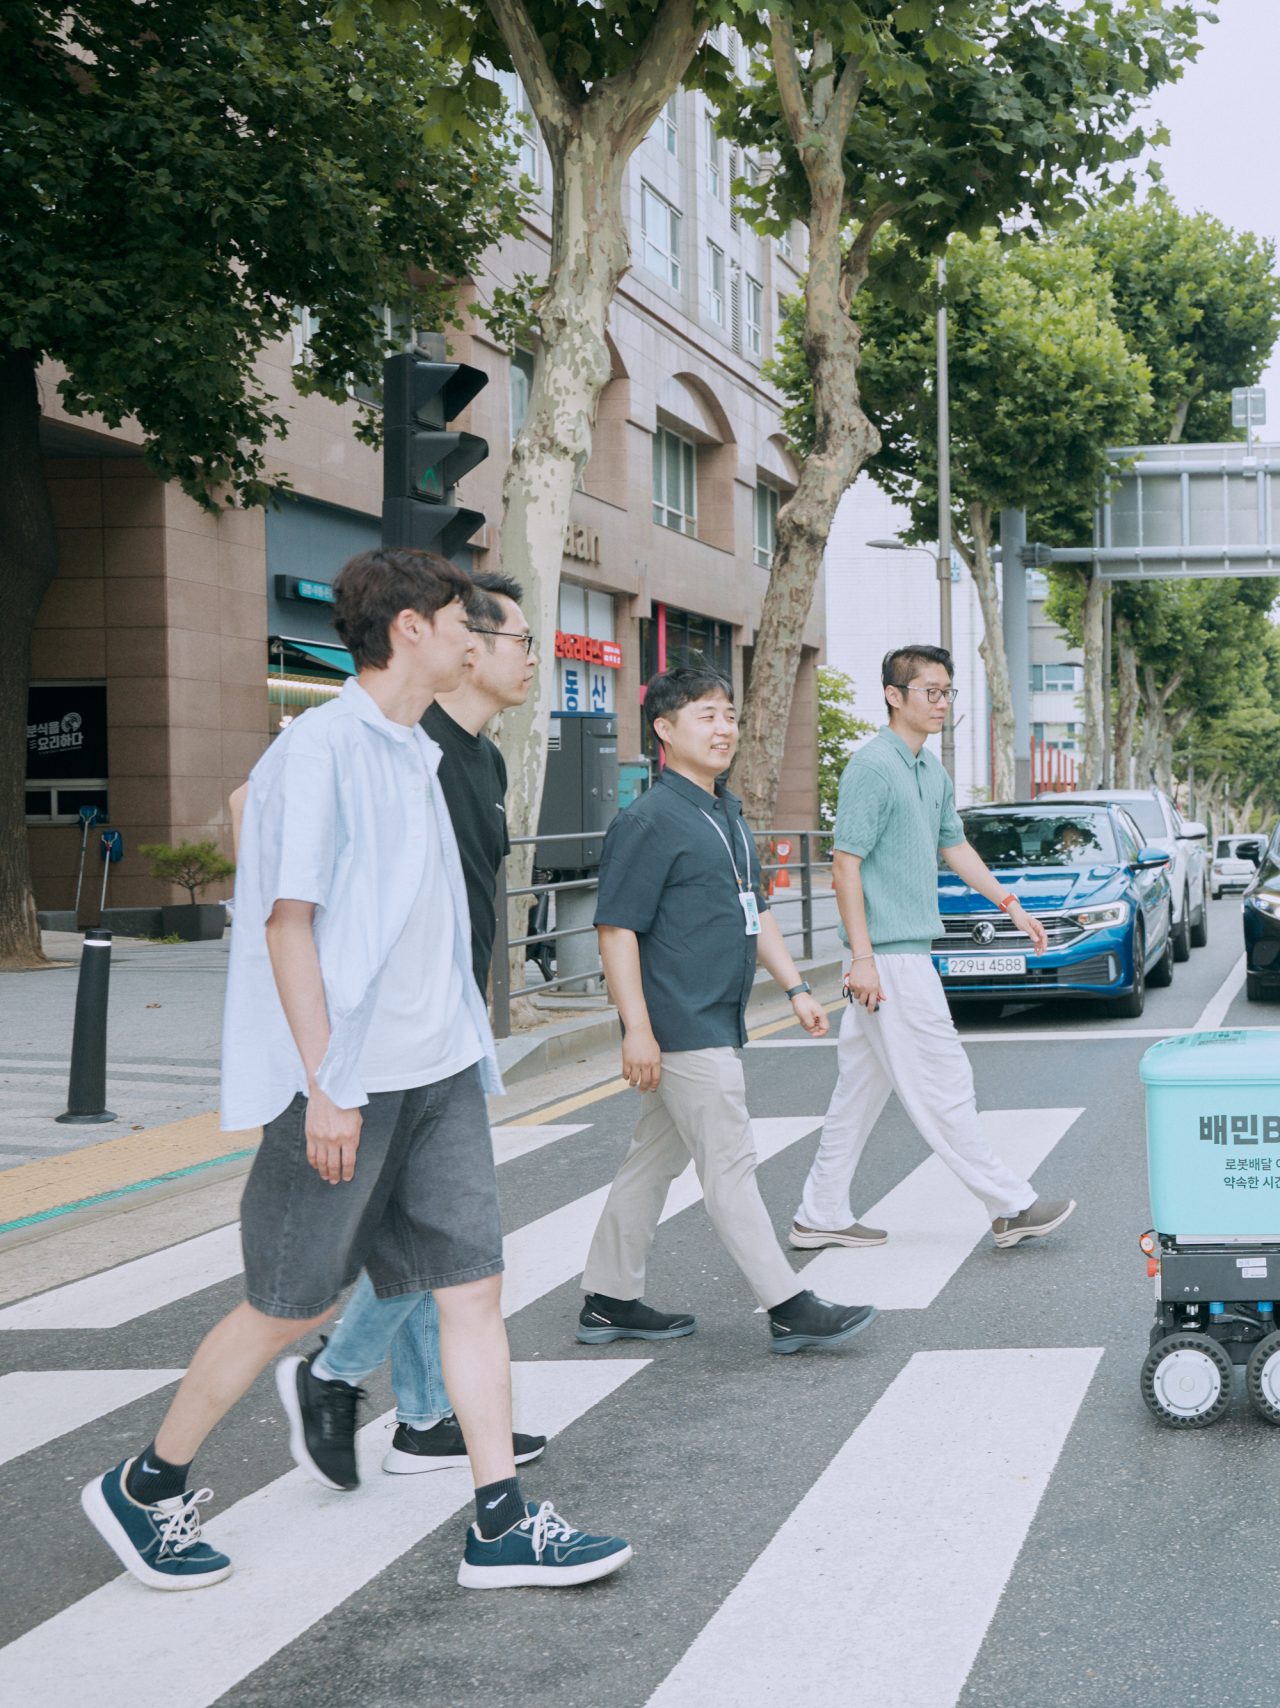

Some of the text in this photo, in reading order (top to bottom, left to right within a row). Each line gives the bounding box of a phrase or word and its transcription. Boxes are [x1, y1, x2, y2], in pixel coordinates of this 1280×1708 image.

[38, 732, 83, 751] 요리하다
[951, 958, 1022, 973] 229너 4588
[1225, 1158, 1272, 1171] 로봇배달
[1223, 1176, 1259, 1189] 약속한
